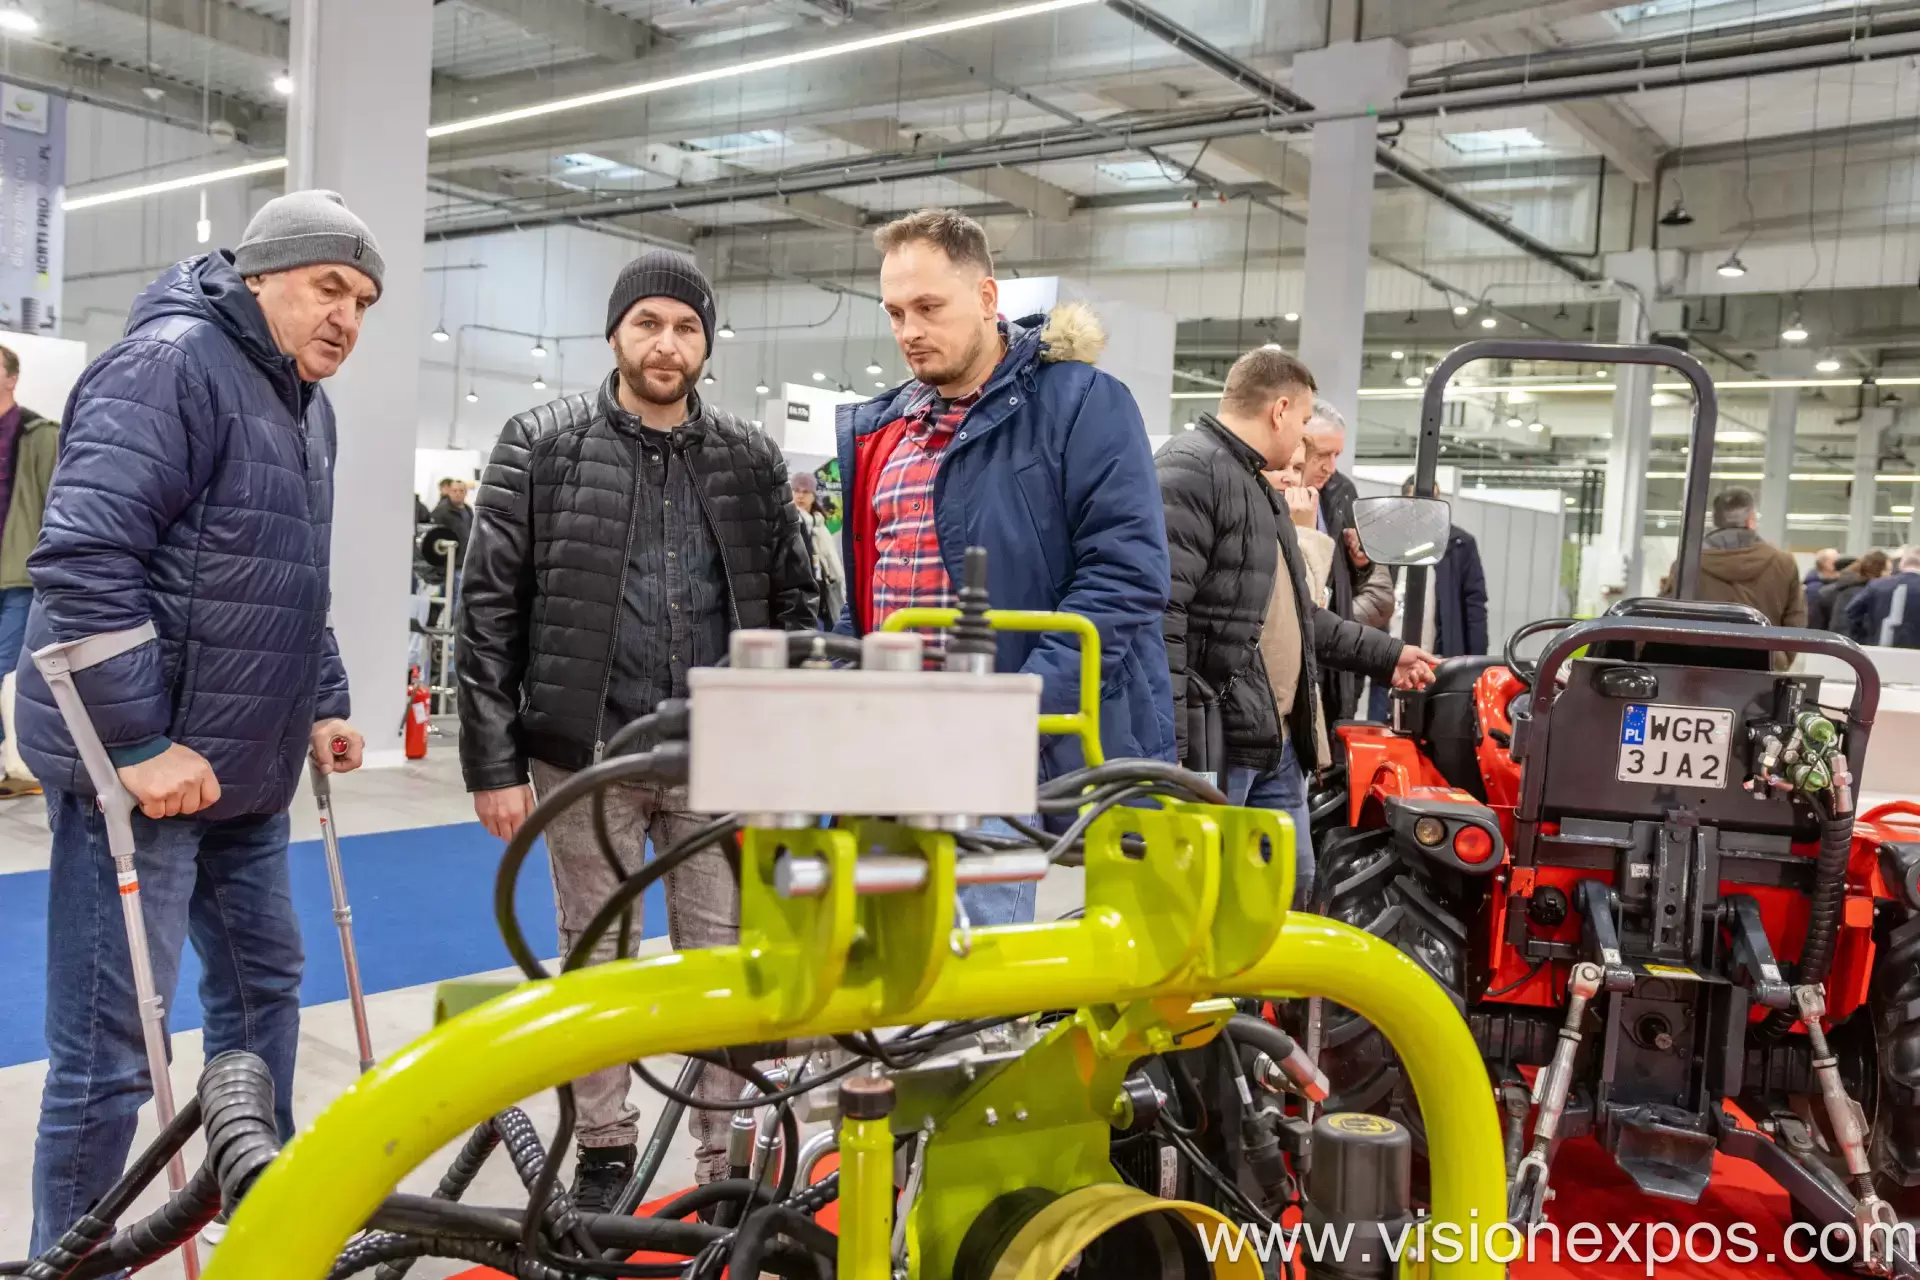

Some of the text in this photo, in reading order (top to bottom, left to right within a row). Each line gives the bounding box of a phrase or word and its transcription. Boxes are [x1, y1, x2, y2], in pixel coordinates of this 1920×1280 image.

[1625, 728, 1642, 742] PL
[1650, 715, 1715, 744] WGR
[1627, 749, 1720, 780] 3JA2
